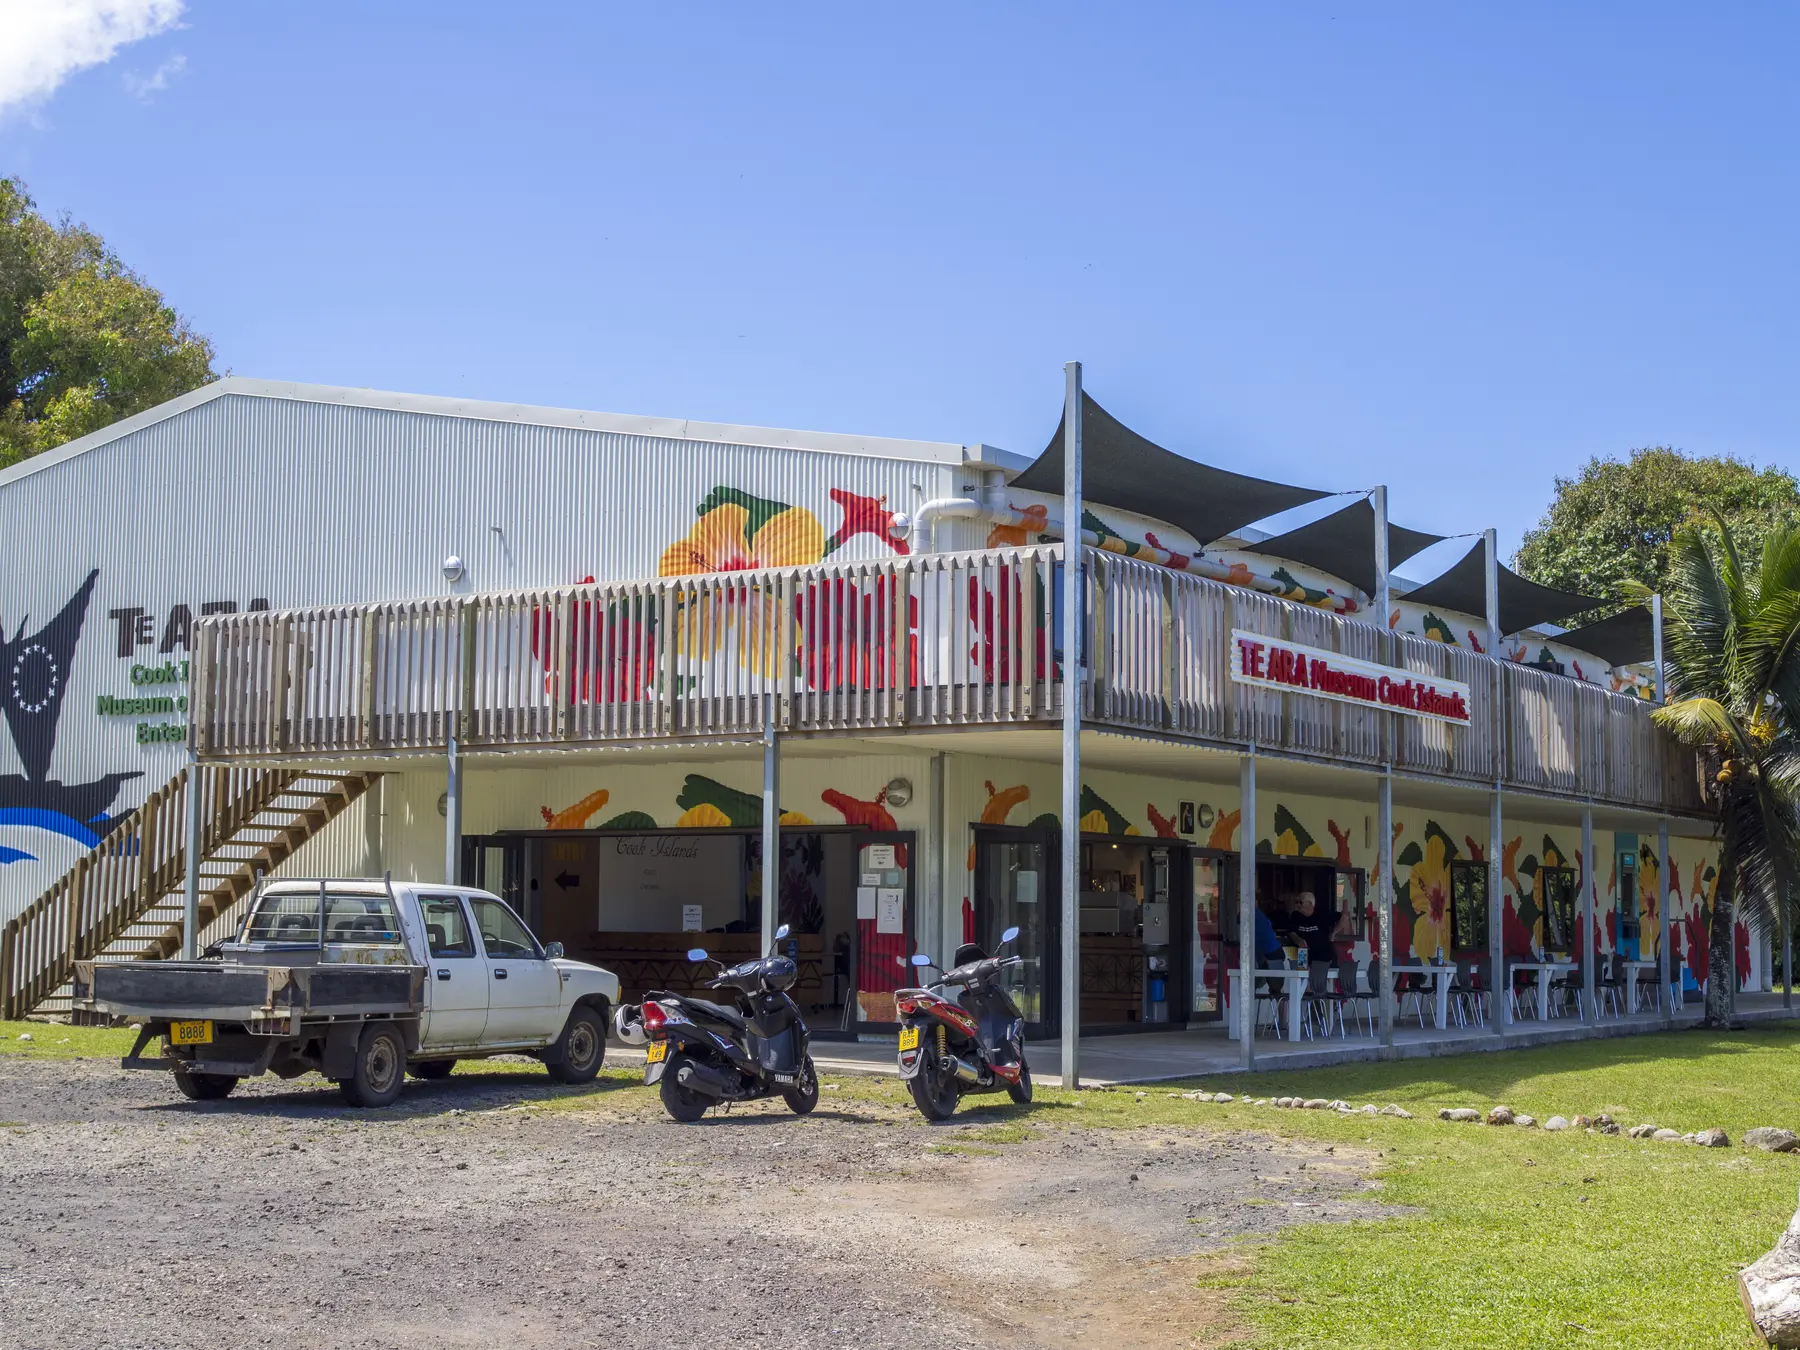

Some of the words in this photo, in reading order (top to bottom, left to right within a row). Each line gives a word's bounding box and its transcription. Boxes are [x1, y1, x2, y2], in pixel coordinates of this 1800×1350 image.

[130, 660, 177, 685] Cook
[1238, 639, 1265, 679] TE
[1267, 647, 1309, 687] ARA
[1310, 659, 1377, 701] Museum
[1378, 675, 1416, 710] Cook
[97, 695, 173, 715] Museum
[136, 722, 188, 744] Enter
[616, 836, 646, 856] Cook
[650, 836, 701, 859] Islands
[180, 1026, 204, 1039] 8080
